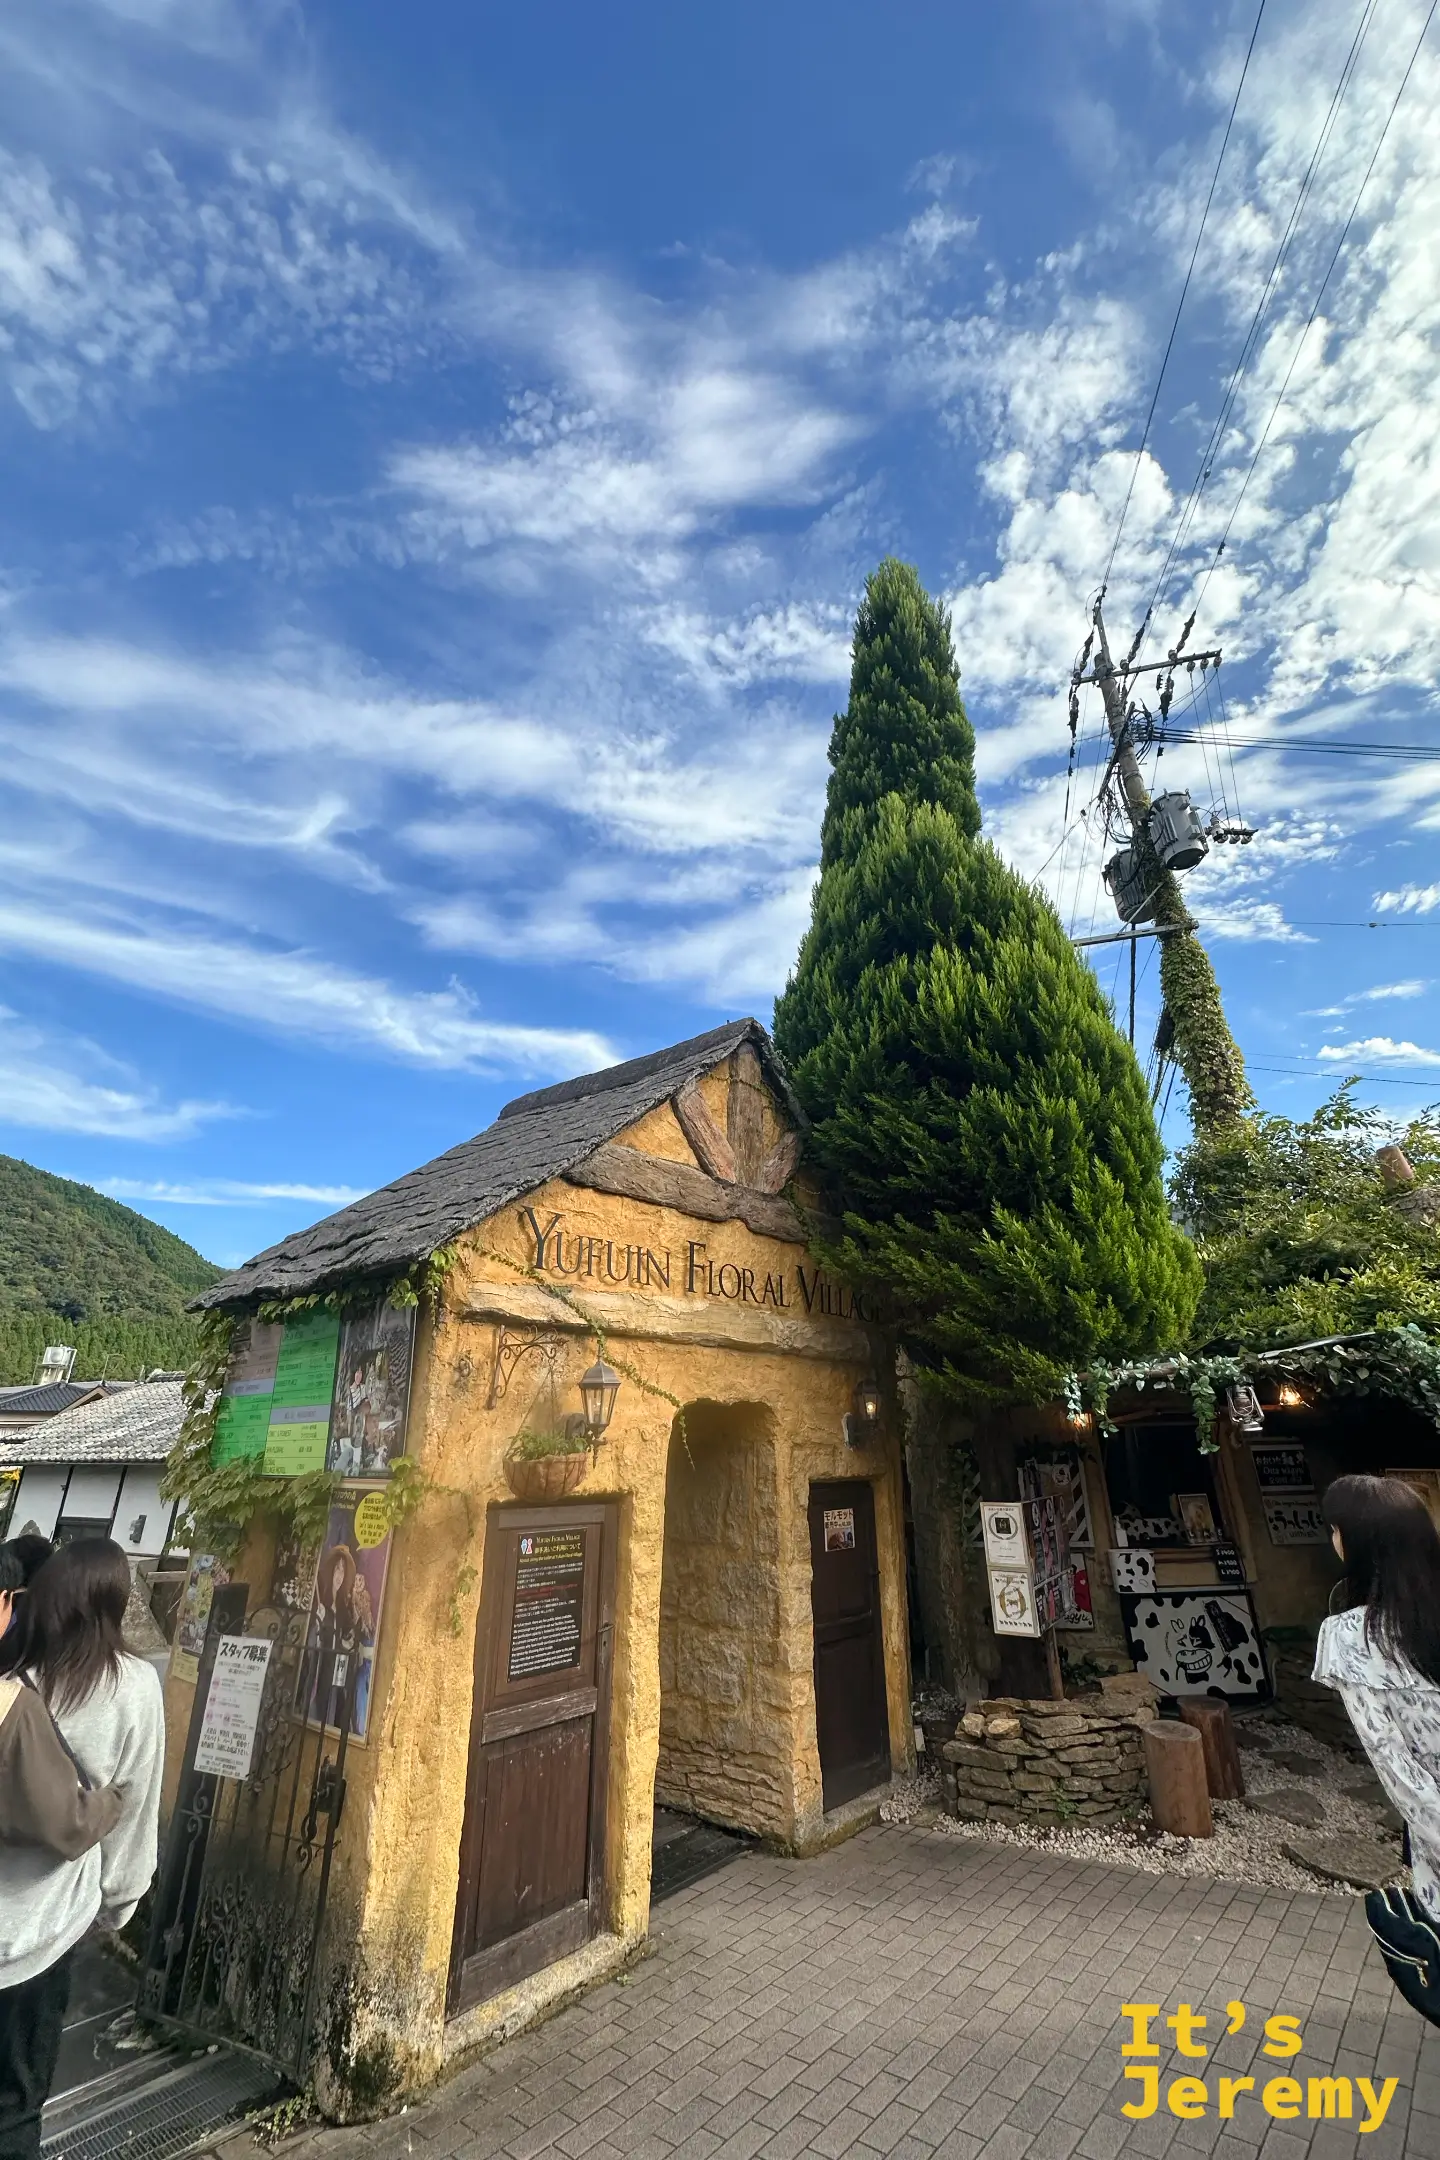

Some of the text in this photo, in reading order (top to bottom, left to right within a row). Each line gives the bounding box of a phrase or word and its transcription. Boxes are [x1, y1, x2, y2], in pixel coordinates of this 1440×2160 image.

[522, 1206, 882, 1322] YUFUIN FLORAL VILLAG
[824, 1509, 854, 1521] モルモット
[219, 1642, 269, 1663] スタッフ募集
